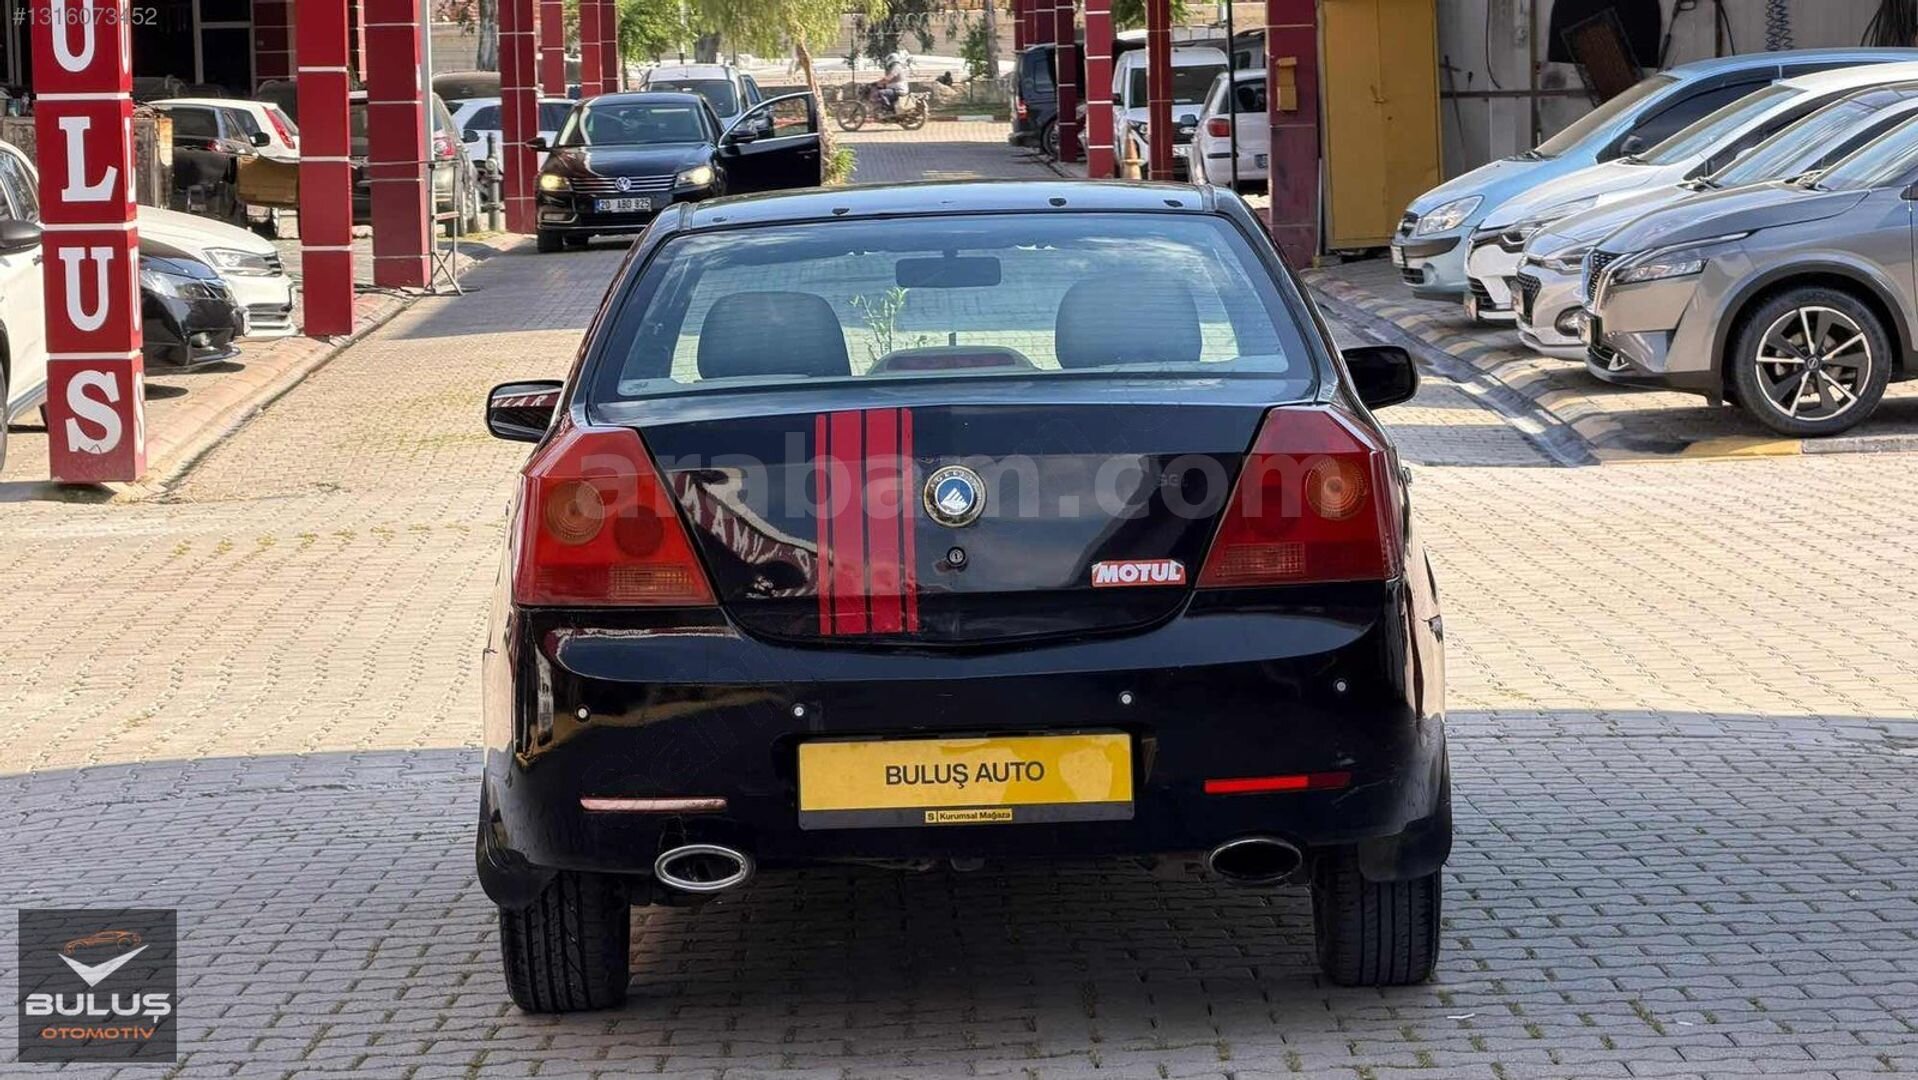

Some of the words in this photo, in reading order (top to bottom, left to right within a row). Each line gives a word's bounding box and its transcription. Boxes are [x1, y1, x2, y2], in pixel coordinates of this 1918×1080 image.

[1096, 563, 1180, 583] MOTUL
[885, 763, 969, 789] BULUŞ
[975, 761, 1045, 782] AUTO
[939, 811, 978, 820] Kurumsal
[979, 810, 1011, 820] Mağaza
